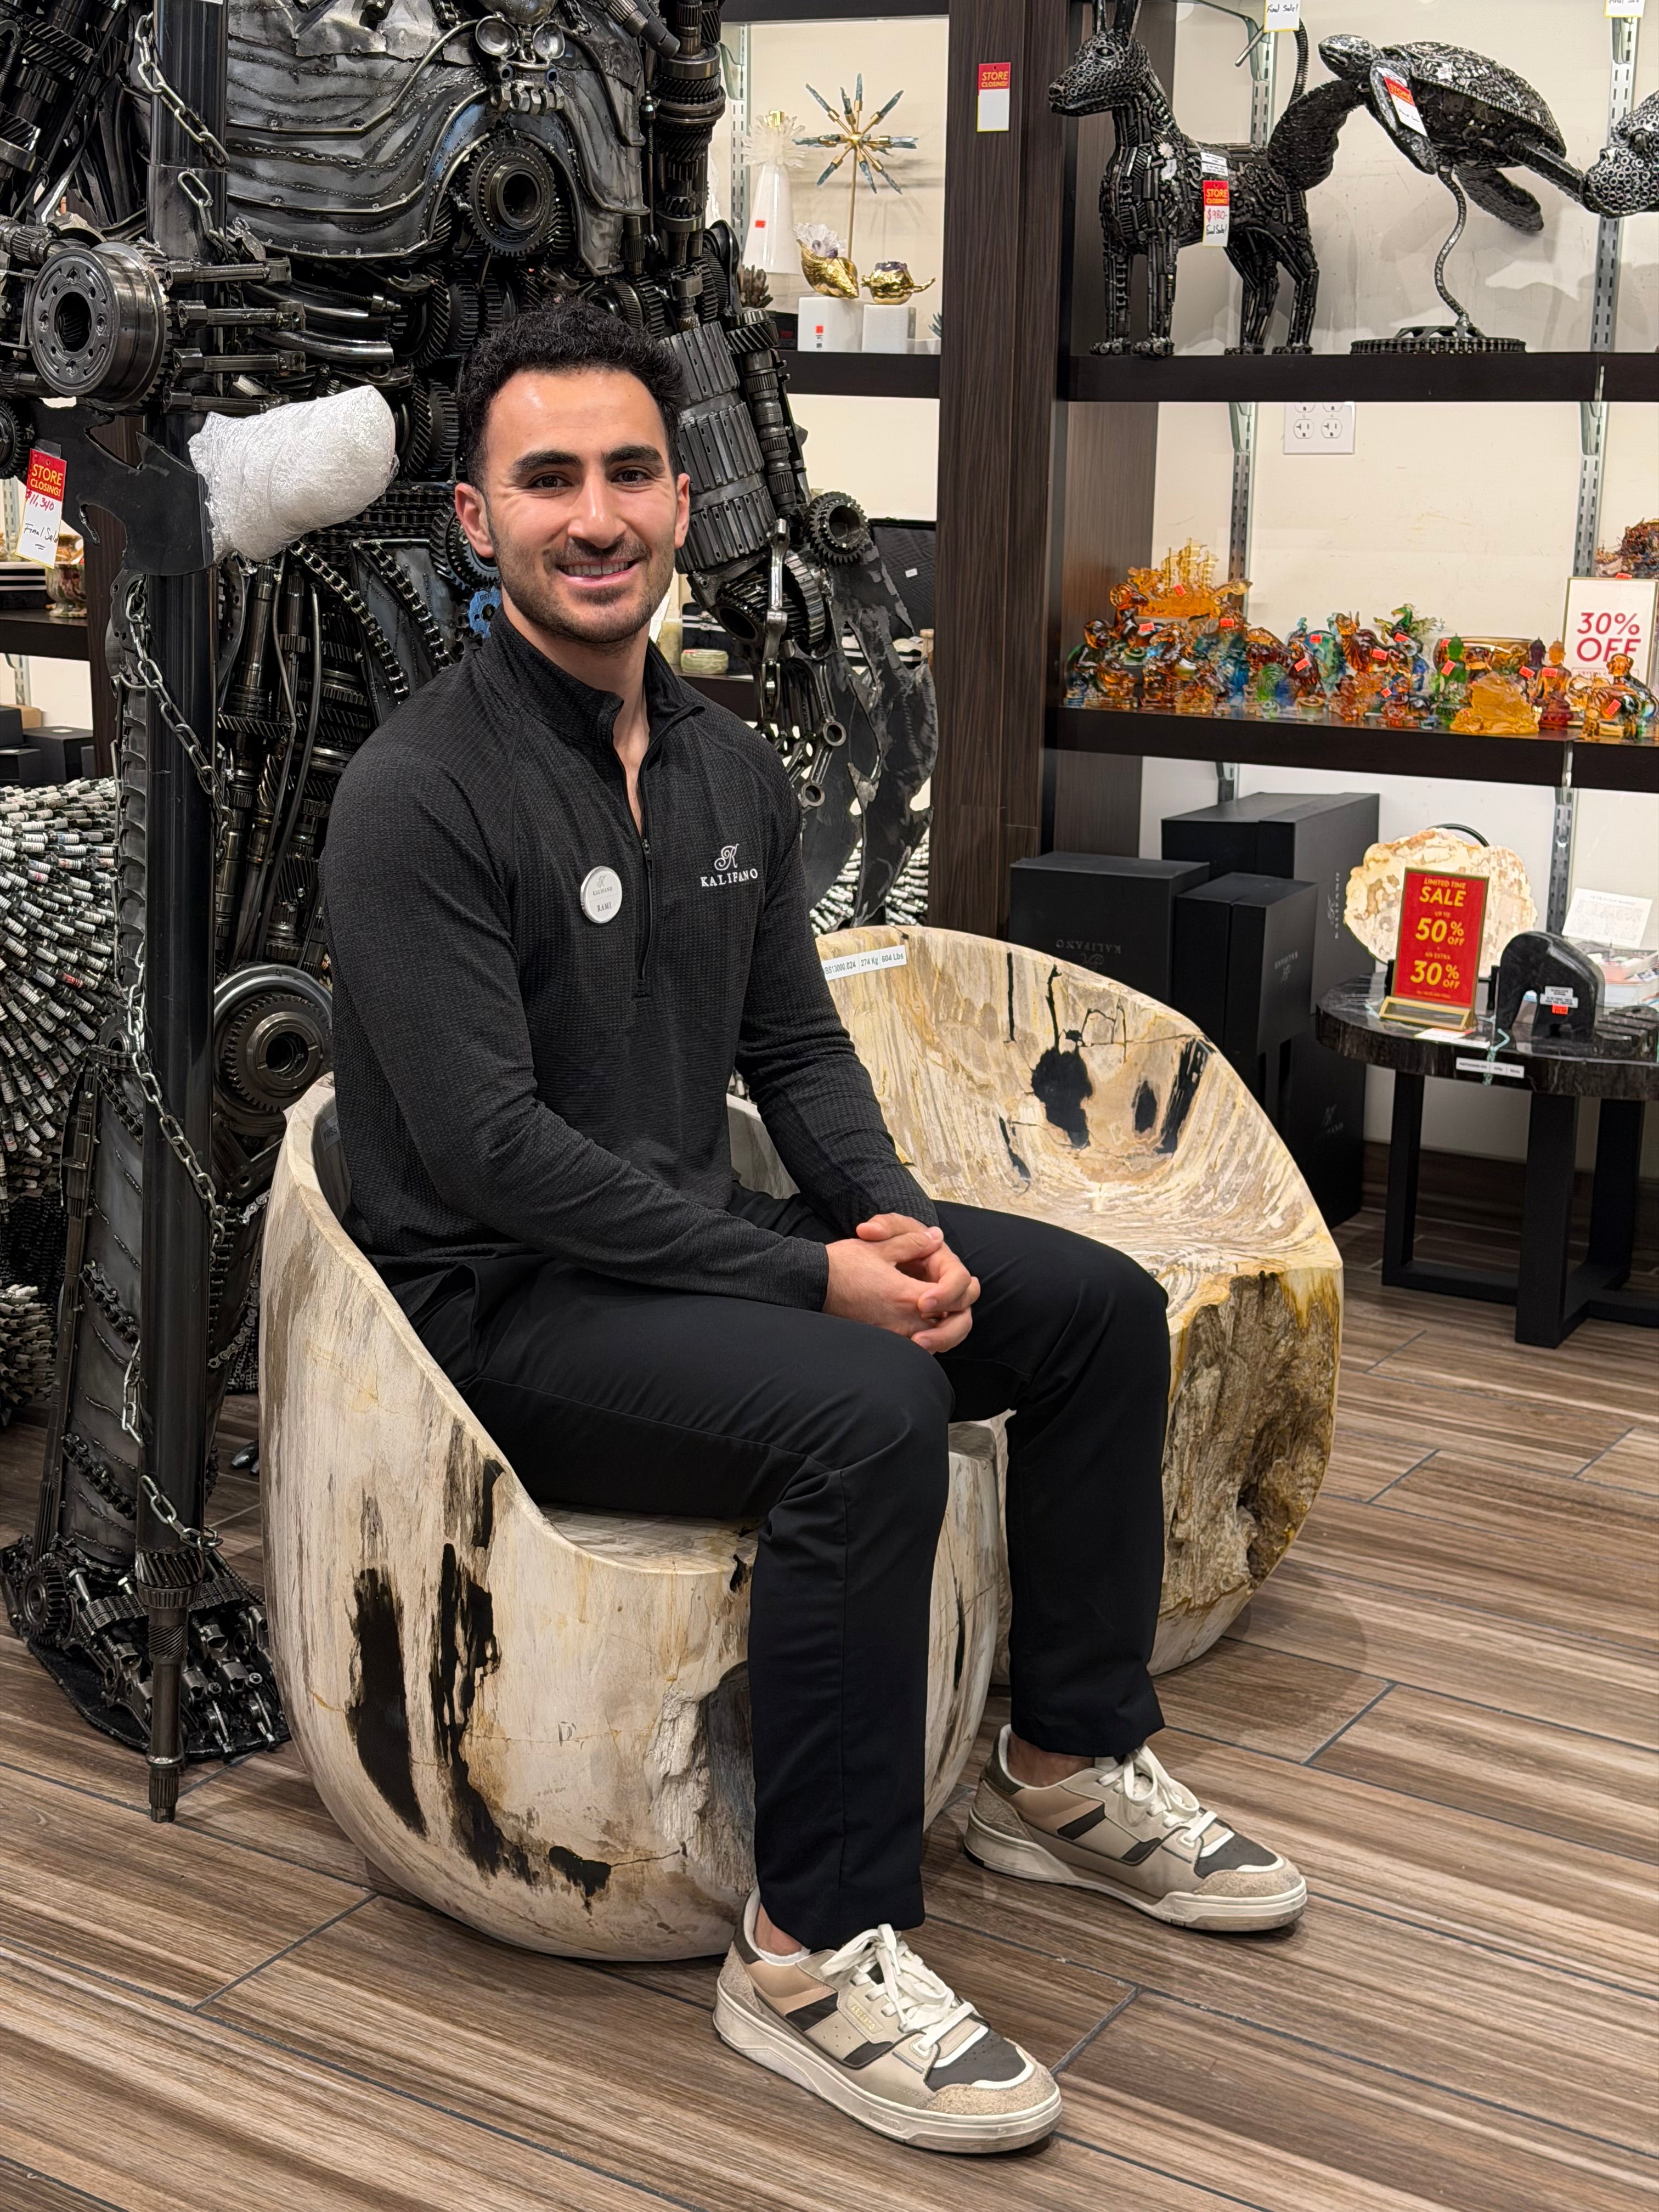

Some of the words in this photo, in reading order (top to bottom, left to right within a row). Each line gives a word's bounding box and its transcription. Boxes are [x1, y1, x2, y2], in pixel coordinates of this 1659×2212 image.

[982, 71, 1008, 81] STORE
[1206, 189, 1227, 198] STORE
[31, 464, 63, 486] STORE
[30, 478, 61, 496] CLOSING!
[24, 523, 45, 538] Final
[1577, 612, 1640, 635] 30%
[1577, 637, 1641, 662] OFF
[701, 868, 758, 887] KALIFANO
[1424, 878, 1449, 887] LIMITED
[1451, 881, 1466, 889] TIME
[1419, 886, 1466, 907] SALE
[597, 901, 612, 912] RAMI
[1447, 936, 1465, 946] OFF
[861, 958, 871, 967] 274
[871, 957, 878, 966] Kg
[882, 954, 892, 962] 604
[1442, 979, 1460, 989] OFF
